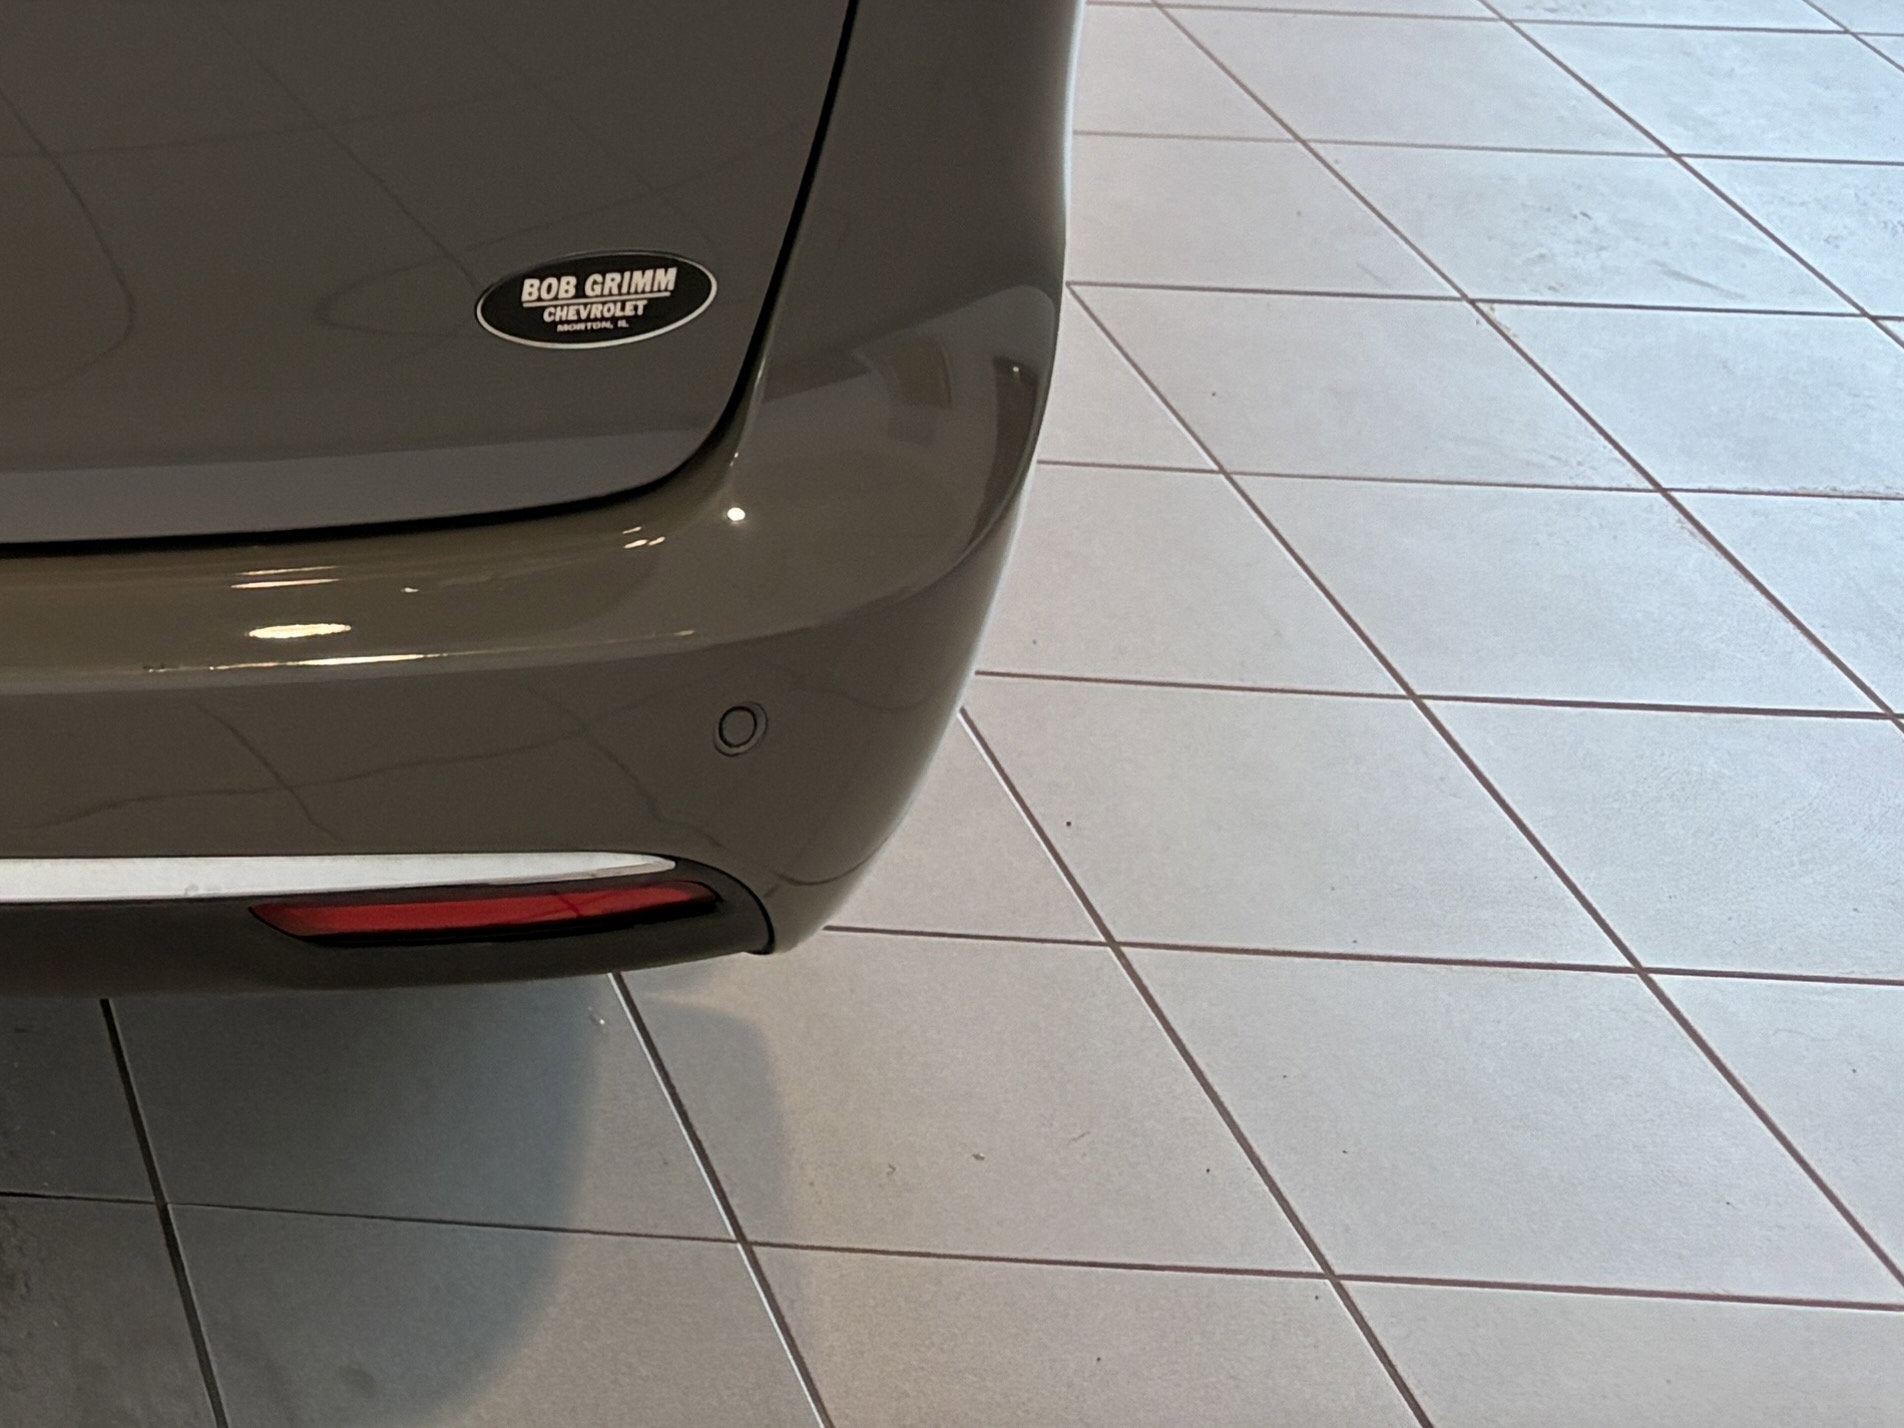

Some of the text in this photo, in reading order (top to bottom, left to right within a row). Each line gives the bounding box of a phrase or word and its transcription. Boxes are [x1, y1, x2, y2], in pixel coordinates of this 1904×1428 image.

[521, 266, 678, 302] BOB GRIMM
[543, 299, 648, 323] CHEVROLET
